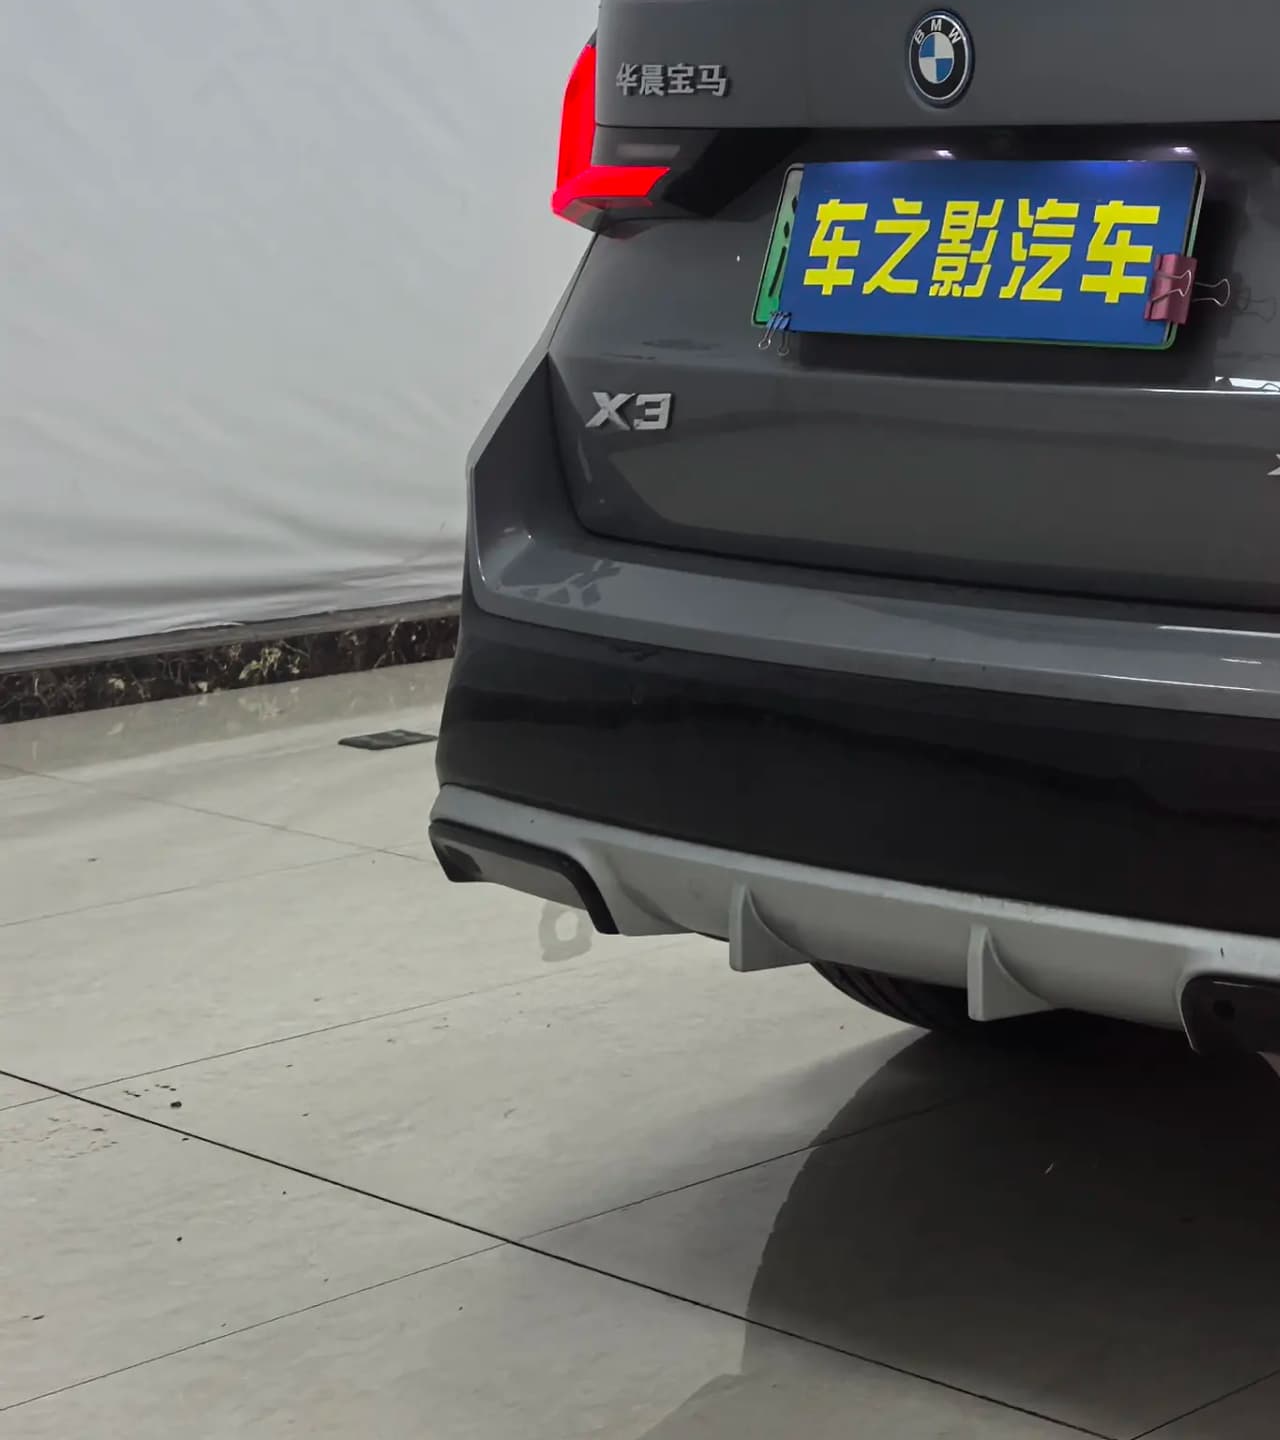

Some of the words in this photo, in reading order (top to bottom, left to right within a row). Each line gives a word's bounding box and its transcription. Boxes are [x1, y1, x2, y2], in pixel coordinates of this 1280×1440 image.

[914, 18, 962, 45] BMW
[616, 62, 727, 97] 华晨宝马
[802, 198, 1161, 303] 车之影汽车
[584, 391, 672, 431] X3
